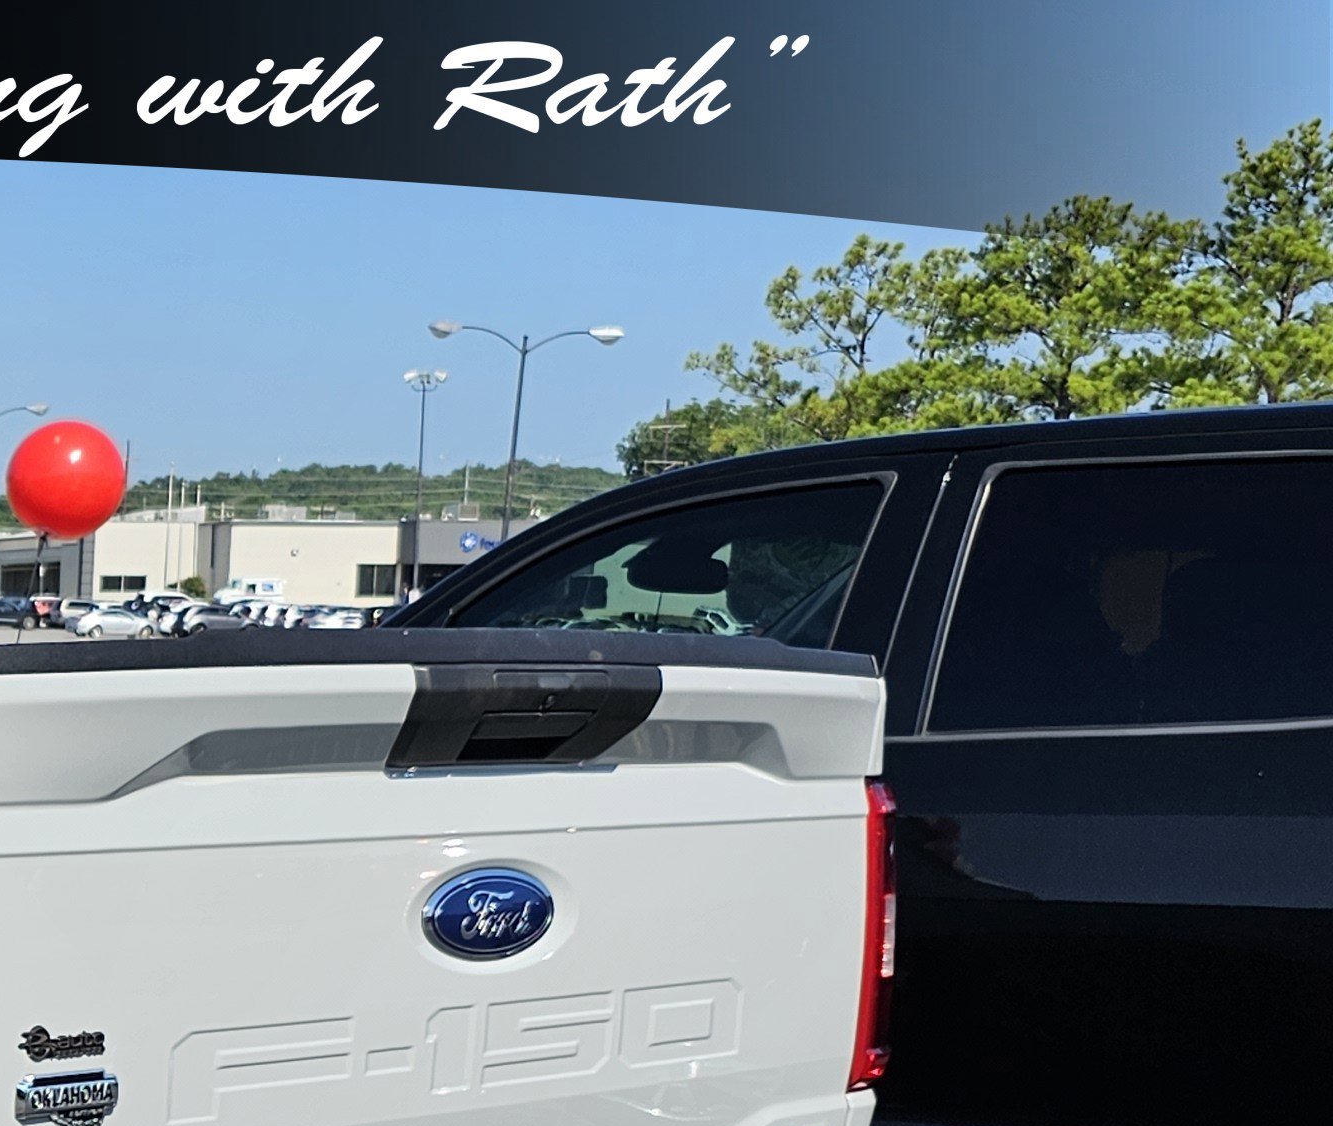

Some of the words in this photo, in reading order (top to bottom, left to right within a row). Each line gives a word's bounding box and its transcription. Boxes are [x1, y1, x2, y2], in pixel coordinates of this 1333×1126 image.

[460, 890, 534, 940] Ford
[166, 976, 745, 1126] F-150
[31, 1081, 114, 1110] OKLAHOMA
